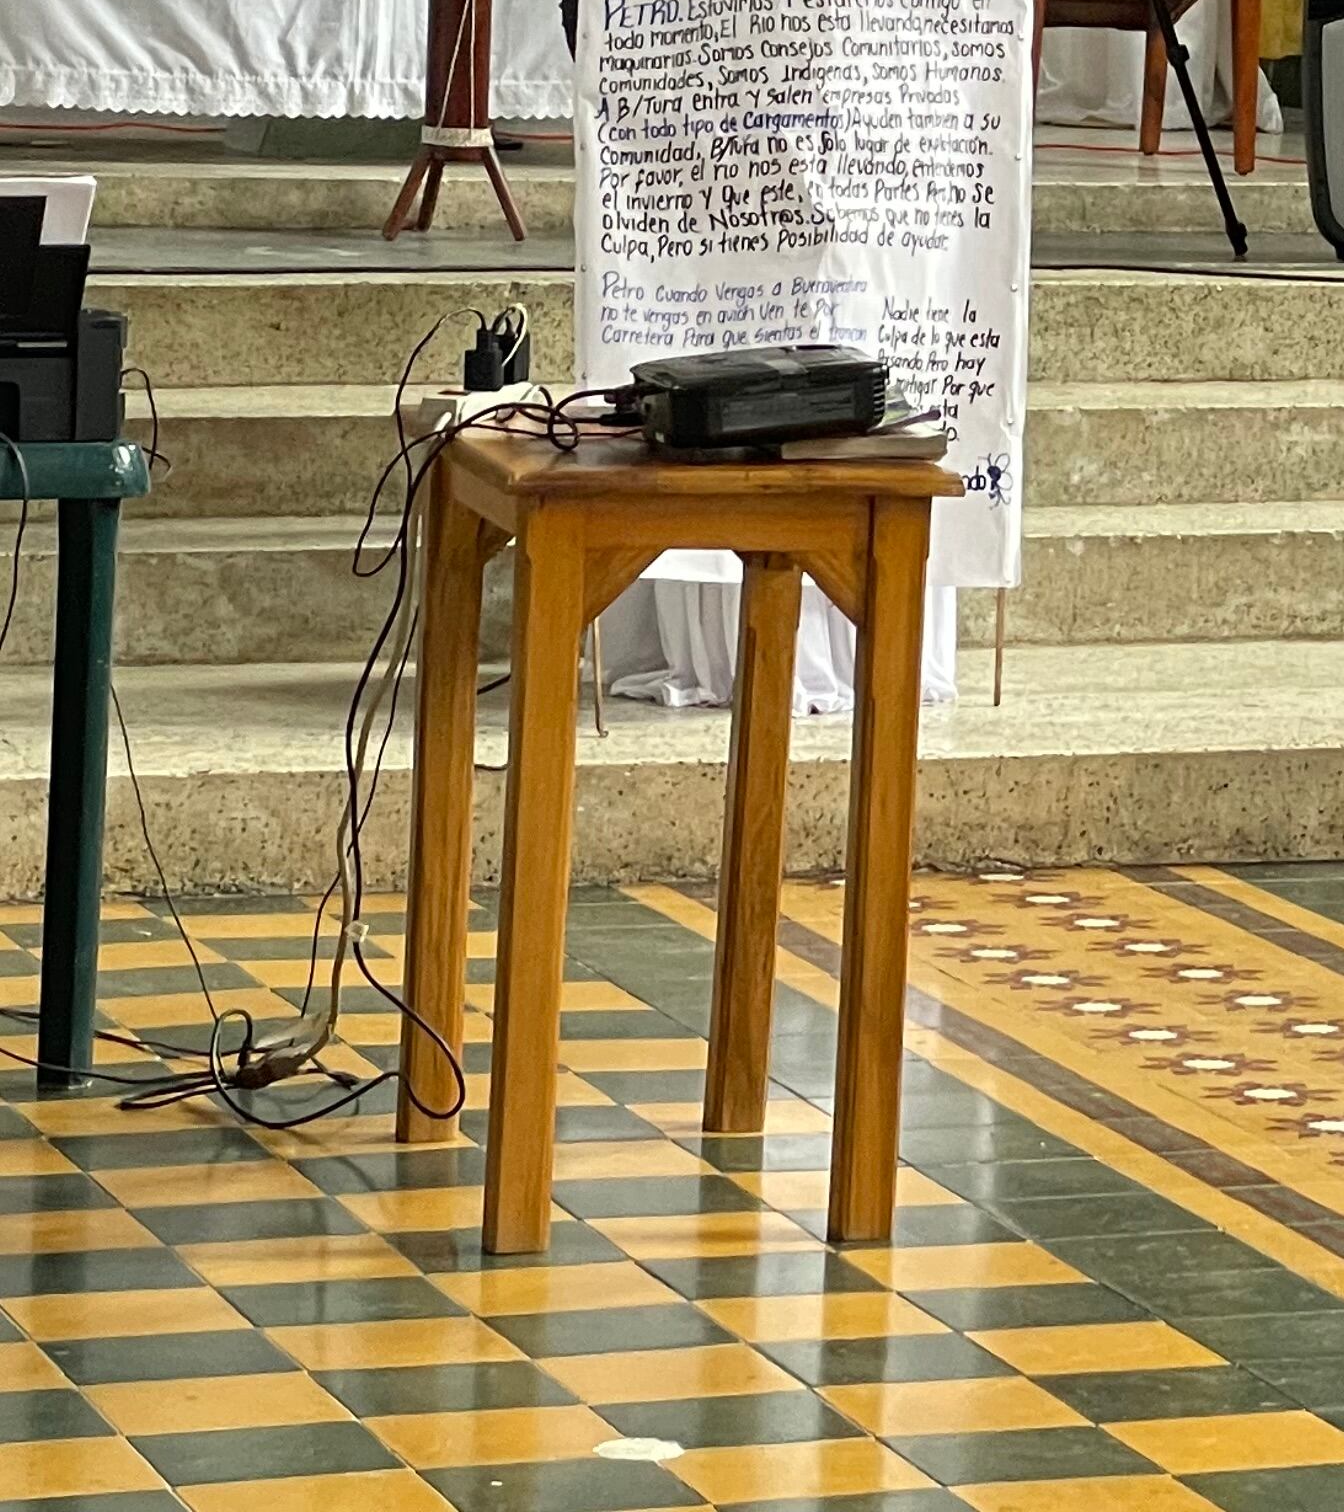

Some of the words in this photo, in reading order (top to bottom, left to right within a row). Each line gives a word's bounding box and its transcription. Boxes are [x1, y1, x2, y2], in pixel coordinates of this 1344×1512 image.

[604, 30, 644, 52] todo
[780, 13, 811, 34] nos
[817, 8, 851, 33] esta
[692, 88, 740, 112] entra
[641, 117, 677, 139] todo
[682, 113, 714, 139] tipo
[719, 114, 739, 134] de
[963, 112, 974, 130] a
[767, 135, 788, 155] no
[795, 135, 814, 153] es
[854, 130, 889, 160] lugar
[894, 133, 911, 155] de
[599, 166, 630, 189] Por
[690, 157, 705, 182] el
[749, 157, 782, 179] nos
[788, 155, 828, 176] esta
[602, 188, 618, 211] el
[677, 211, 701, 234] de
[914, 207, 930, 226] no
[974, 206, 991, 230] la
[719, 231, 769, 254] tienes
[876, 224, 895, 247] de
[602, 270, 645, 301] Petro
[600, 304, 618, 324] no
[622, 302, 637, 318] te
[695, 309, 712, 327] en
[881, 296, 920, 323] Nadie
[962, 297, 977, 324] la
[722, 330, 748, 350] que
[808, 320, 821, 340] el
[910, 325, 926, 347] de
[930, 328, 941, 347] lo
[944, 330, 966, 355] que
[969, 326, 1001, 349] esta
[954, 350, 986, 376] hay
[941, 374, 967, 397] Por
[968, 380, 995, 404] que
